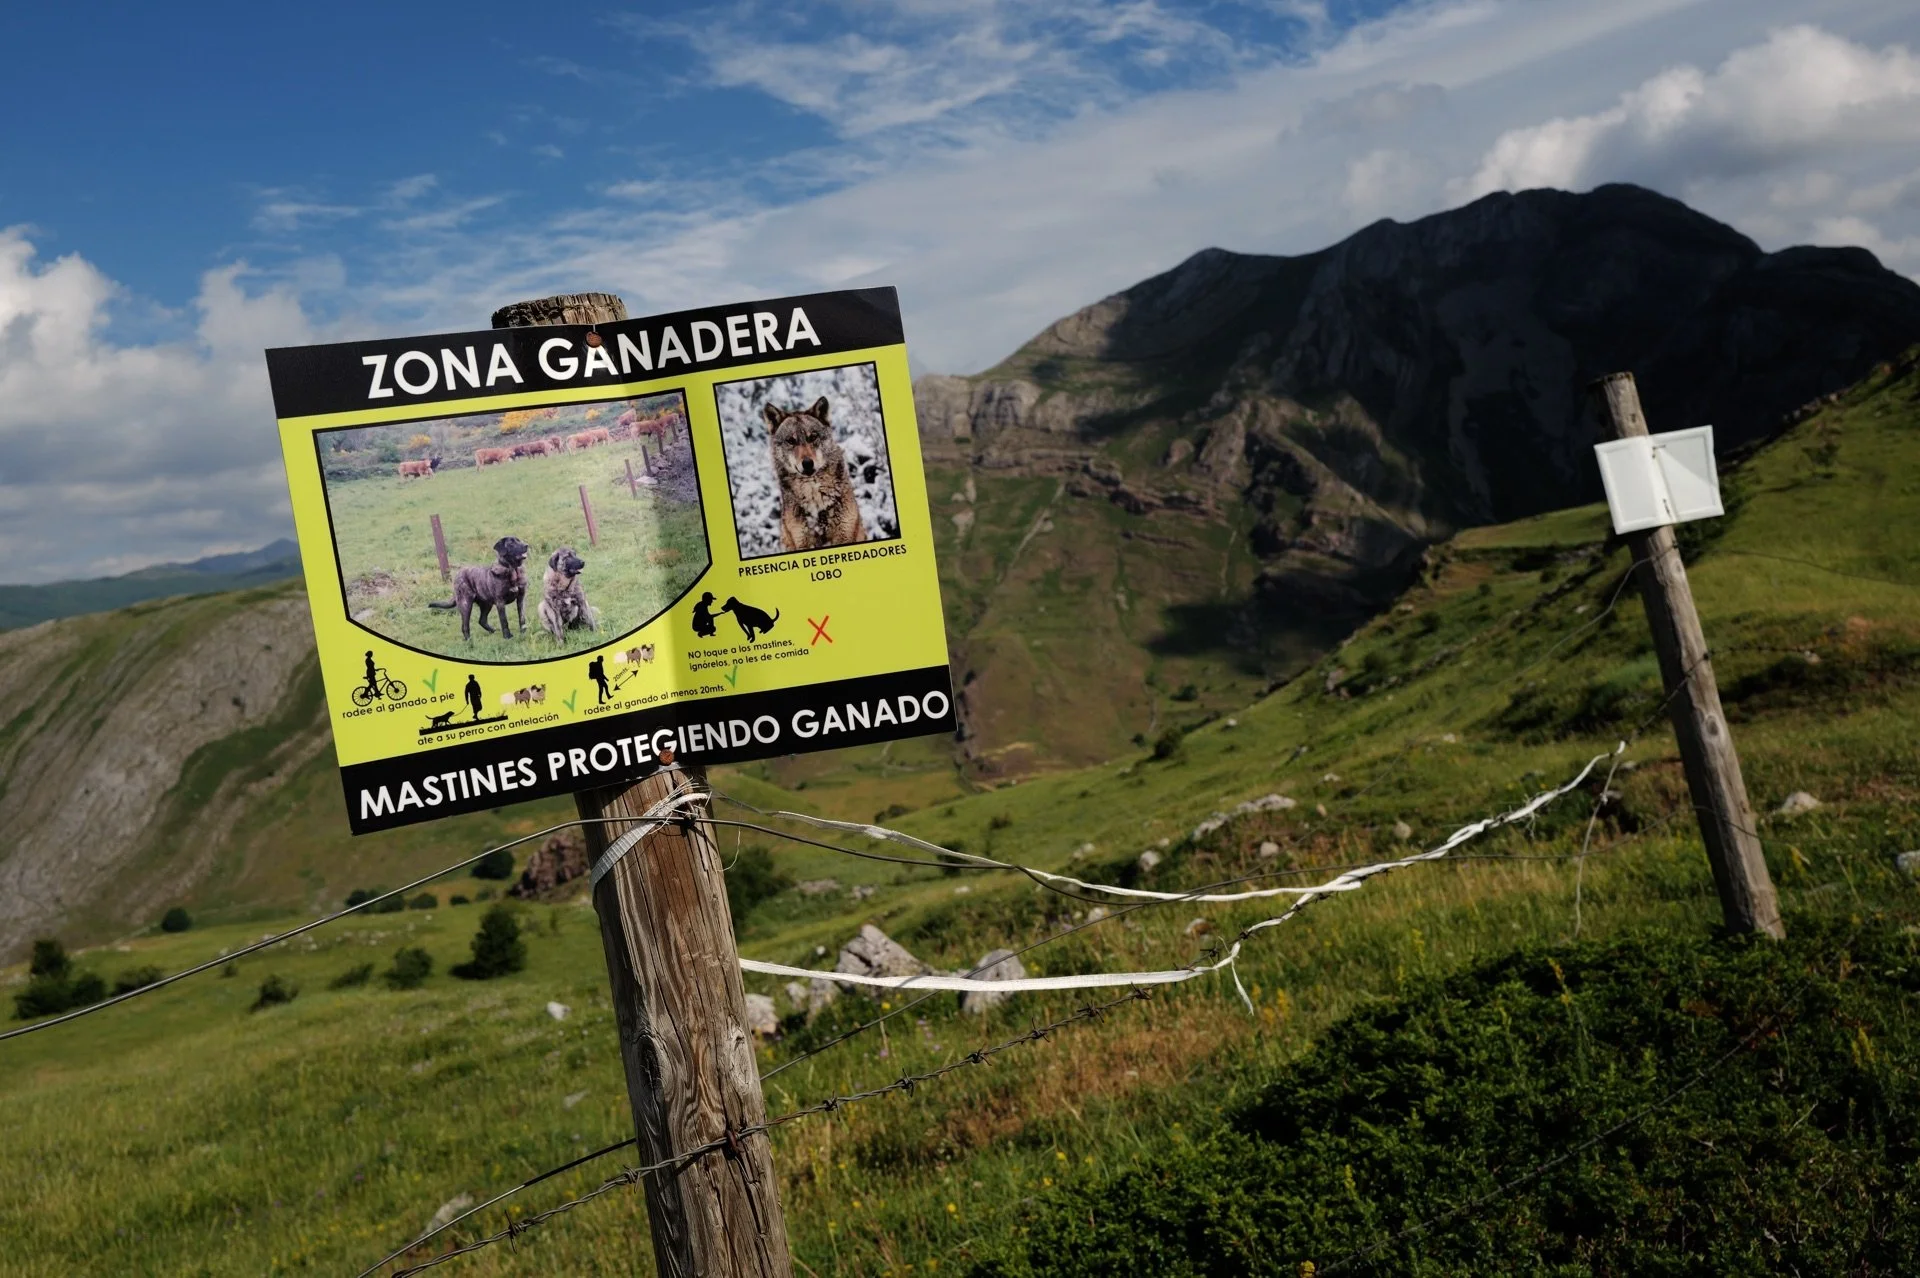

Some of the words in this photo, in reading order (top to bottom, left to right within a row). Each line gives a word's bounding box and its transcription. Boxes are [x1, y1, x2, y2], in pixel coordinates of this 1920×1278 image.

[362, 343, 524, 399] ZONA
[538, 307, 821, 380] GANADERA
[738, 560, 799, 577] PRESENCIA
[802, 557, 817, 568] DE
[820, 544, 907, 565] DEPREDADORES
[811, 568, 842, 582] LOBO
[688, 650, 702, 660] NO
[703, 649, 728, 659] toque
[738, 645, 751, 653] los
[732, 657, 744, 665] no
[746, 655, 758, 664] les
[760, 653, 772, 662] de
[774, 648, 809, 659] comida
[342, 706, 373, 718] rodee
[376, 703, 385, 713] al
[388, 698, 427, 712] ganado
[440, 692, 455, 703] pie
[584, 703, 611, 715] rodee
[613, 701, 622, 710] al
[624, 694, 659, 709] ganado
[661, 691, 669, 701] al
[670, 689, 698, 698] menos
[417, 735, 434, 746] ate
[446, 732, 456, 740] su
[459, 728, 485, 739] perro
[487, 723, 506, 732] con
[508, 712, 560, 729] antelación
[359, 756, 537, 819] MASTINES
[547, 714, 780, 780] PROTEGIENDO
[791, 690, 949, 738] GANADO
